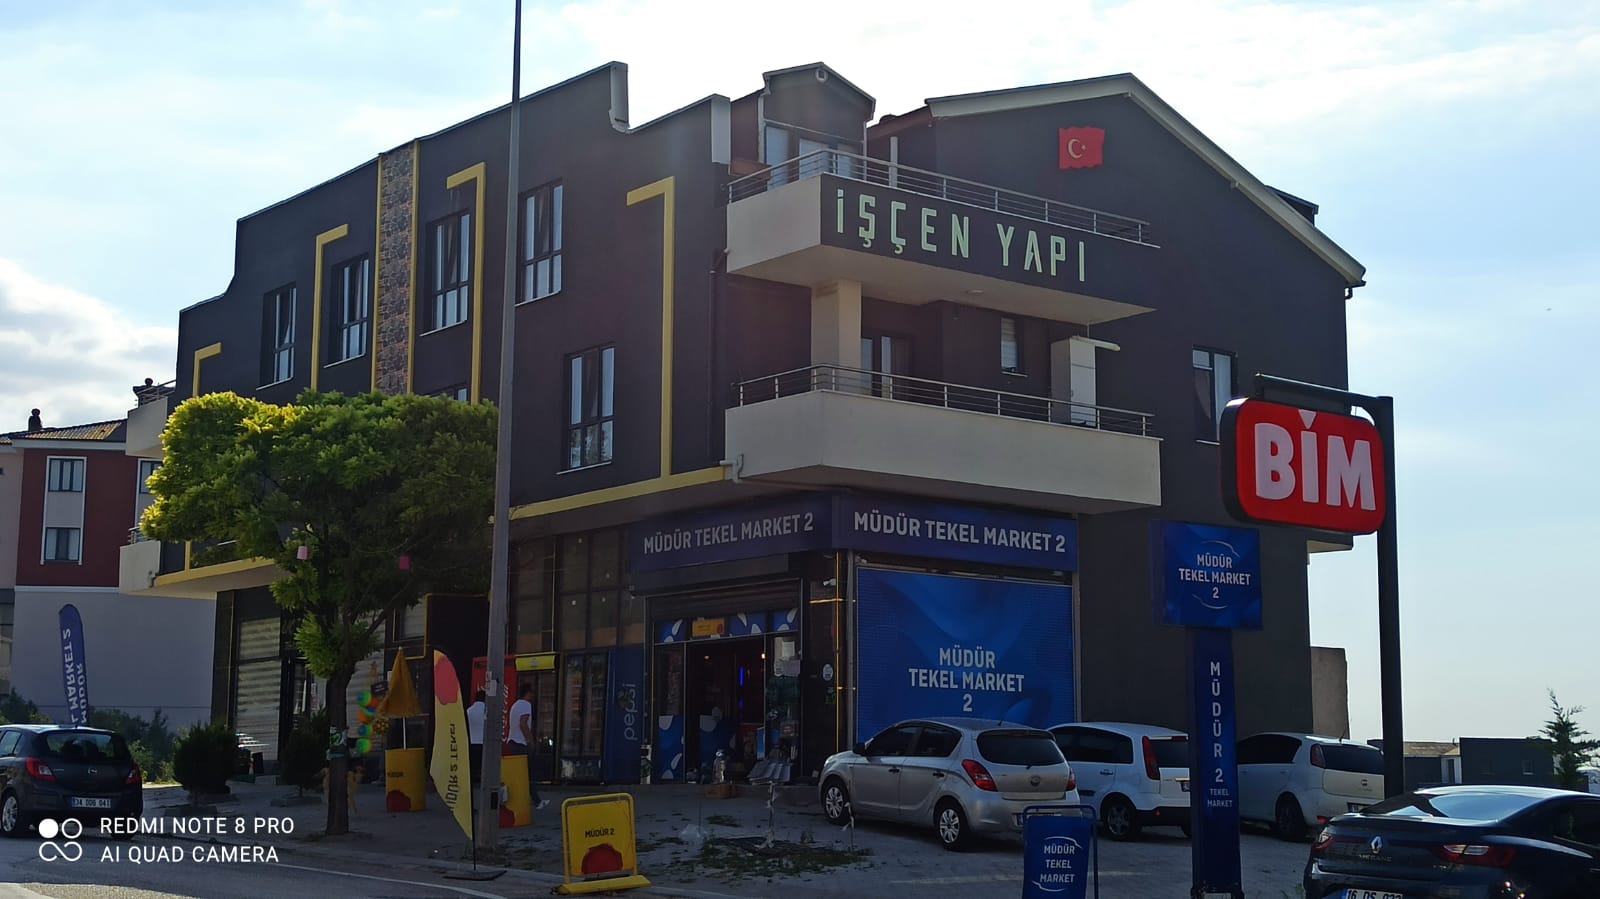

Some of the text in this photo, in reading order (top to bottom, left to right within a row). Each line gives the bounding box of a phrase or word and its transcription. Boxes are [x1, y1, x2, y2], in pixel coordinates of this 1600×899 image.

[837, 189, 1085, 282] İŞÇEN YAPI
[1254, 409, 1376, 511] BİM
[644, 512, 814, 554] MÜDÜR TEKEL MARKET 2
[854, 509, 1066, 553] MÜDÜR TEKEL MARKET 2
[1196, 552, 1233, 568] MÜDÜR
[1178, 568, 1251, 585] TEKEL MARKET
[1212, 587, 1220, 599] 2
[939, 644, 996, 669] MÜDÜR
[908, 668, 1025, 692] TEKEL MARKET
[962, 694, 973, 712] 2
[1210, 661, 1224, 783] MÜDÜR 2
[1210, 788, 1230, 796] TEKEL
[1207, 800, 1233, 808] MARKET
[1043, 843, 1075, 854] MÜDÜR
[1045, 859, 1072, 869] TEKEL
[1040, 873, 1076, 883] MARKET
